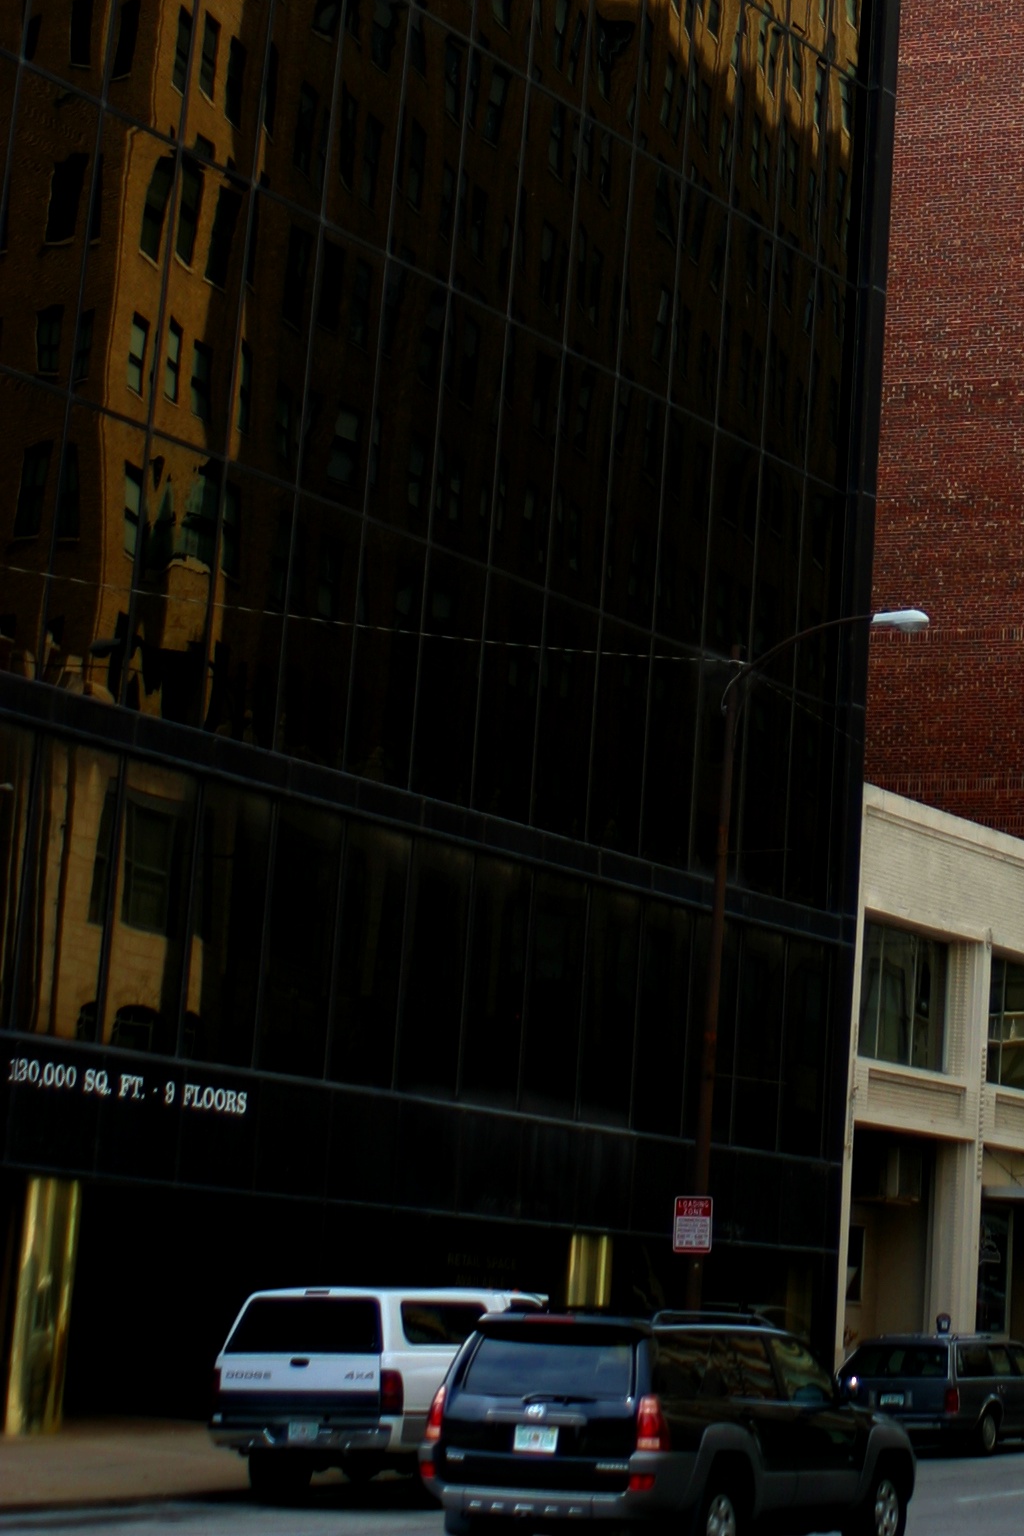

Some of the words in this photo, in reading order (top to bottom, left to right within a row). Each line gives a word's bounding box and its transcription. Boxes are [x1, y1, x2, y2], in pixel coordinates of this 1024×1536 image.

[83, 1068, 111, 1096] SQ.
[118, 1073, 146, 1100] FT.
[164, 1080, 175, 1104] 9
[182, 1083, 247, 1114] FLOORS
[678, 1199, 710, 1208] LOADING
[683, 1208, 703, 1216] ZONE
[225, 1370, 272, 1380] DODGE
